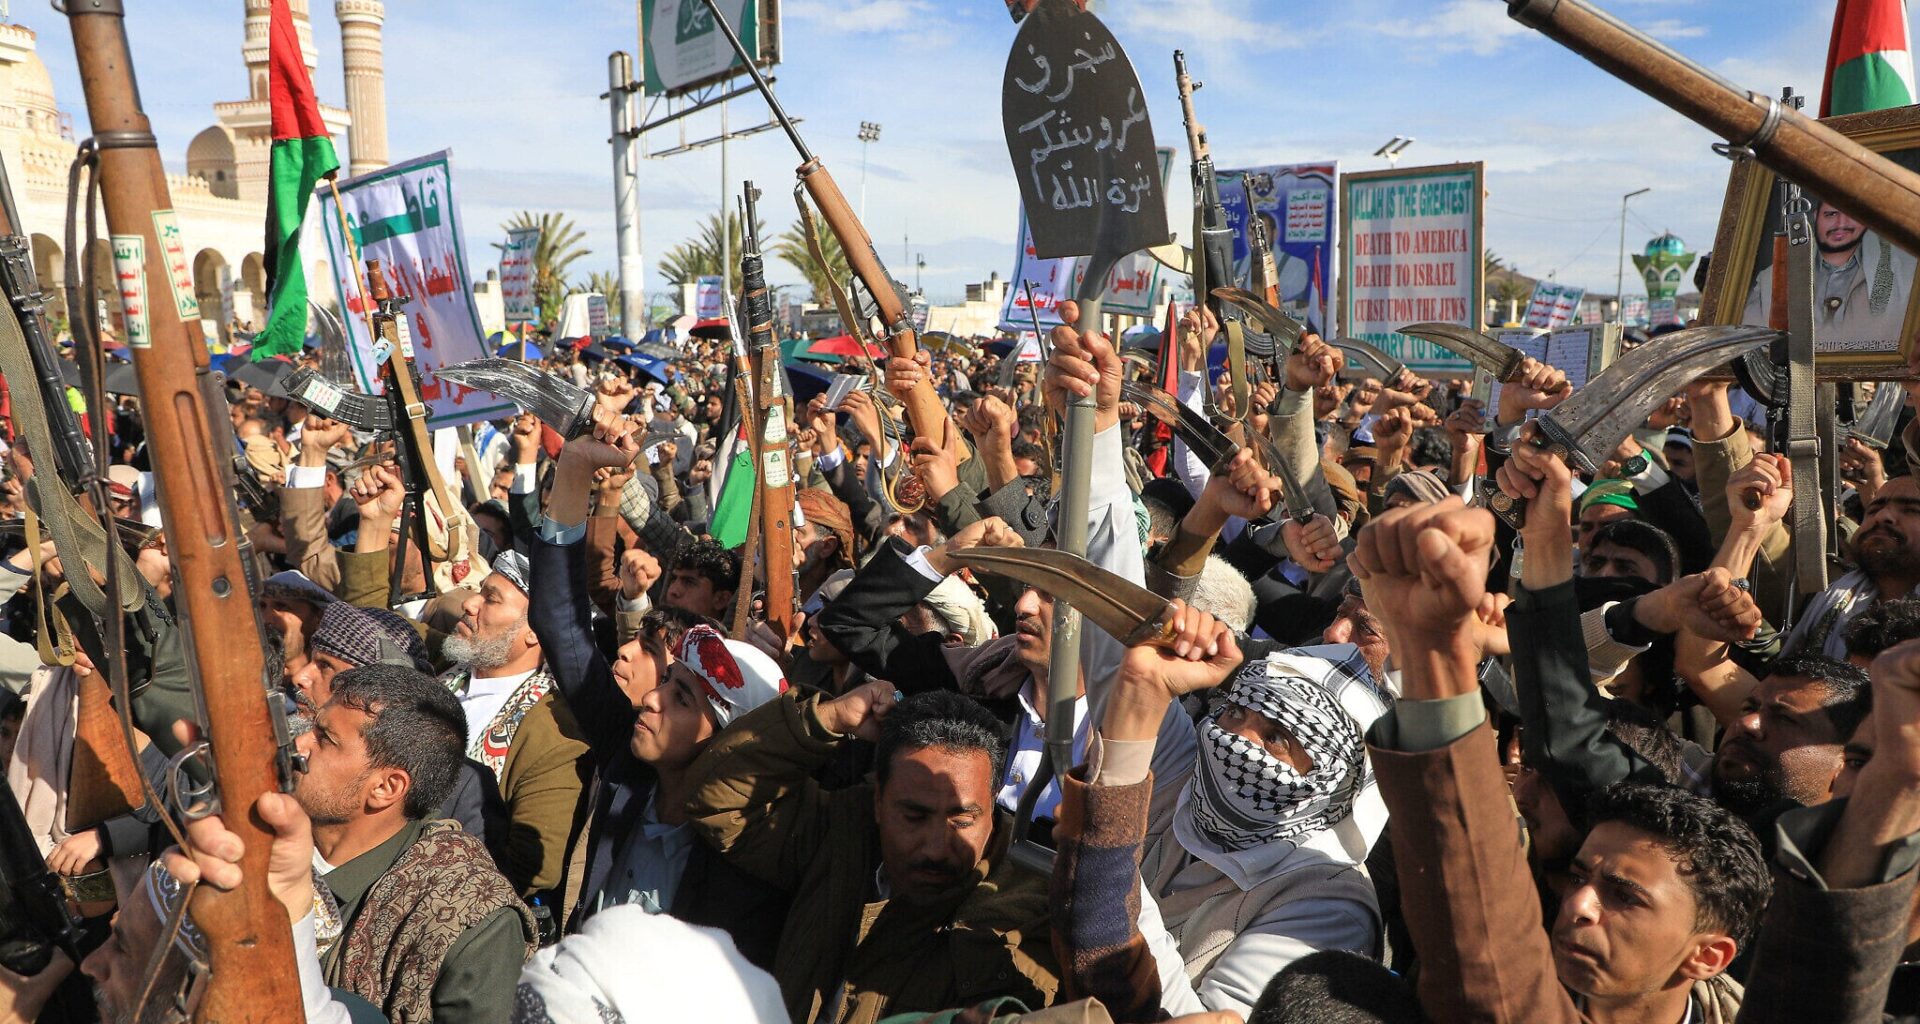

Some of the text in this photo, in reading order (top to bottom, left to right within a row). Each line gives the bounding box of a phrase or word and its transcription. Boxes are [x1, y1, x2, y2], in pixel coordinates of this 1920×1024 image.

[1354, 180, 1472, 220] ALLAH IS THE GREATEST
[1355, 228, 1468, 257] DEATH TO AMERICA
[1355, 262, 1457, 288] DEATH TO ISRAEL
[1354, 297, 1467, 323] CURSE UPON THE JEWS
[1409, 335, 1426, 359] TO
